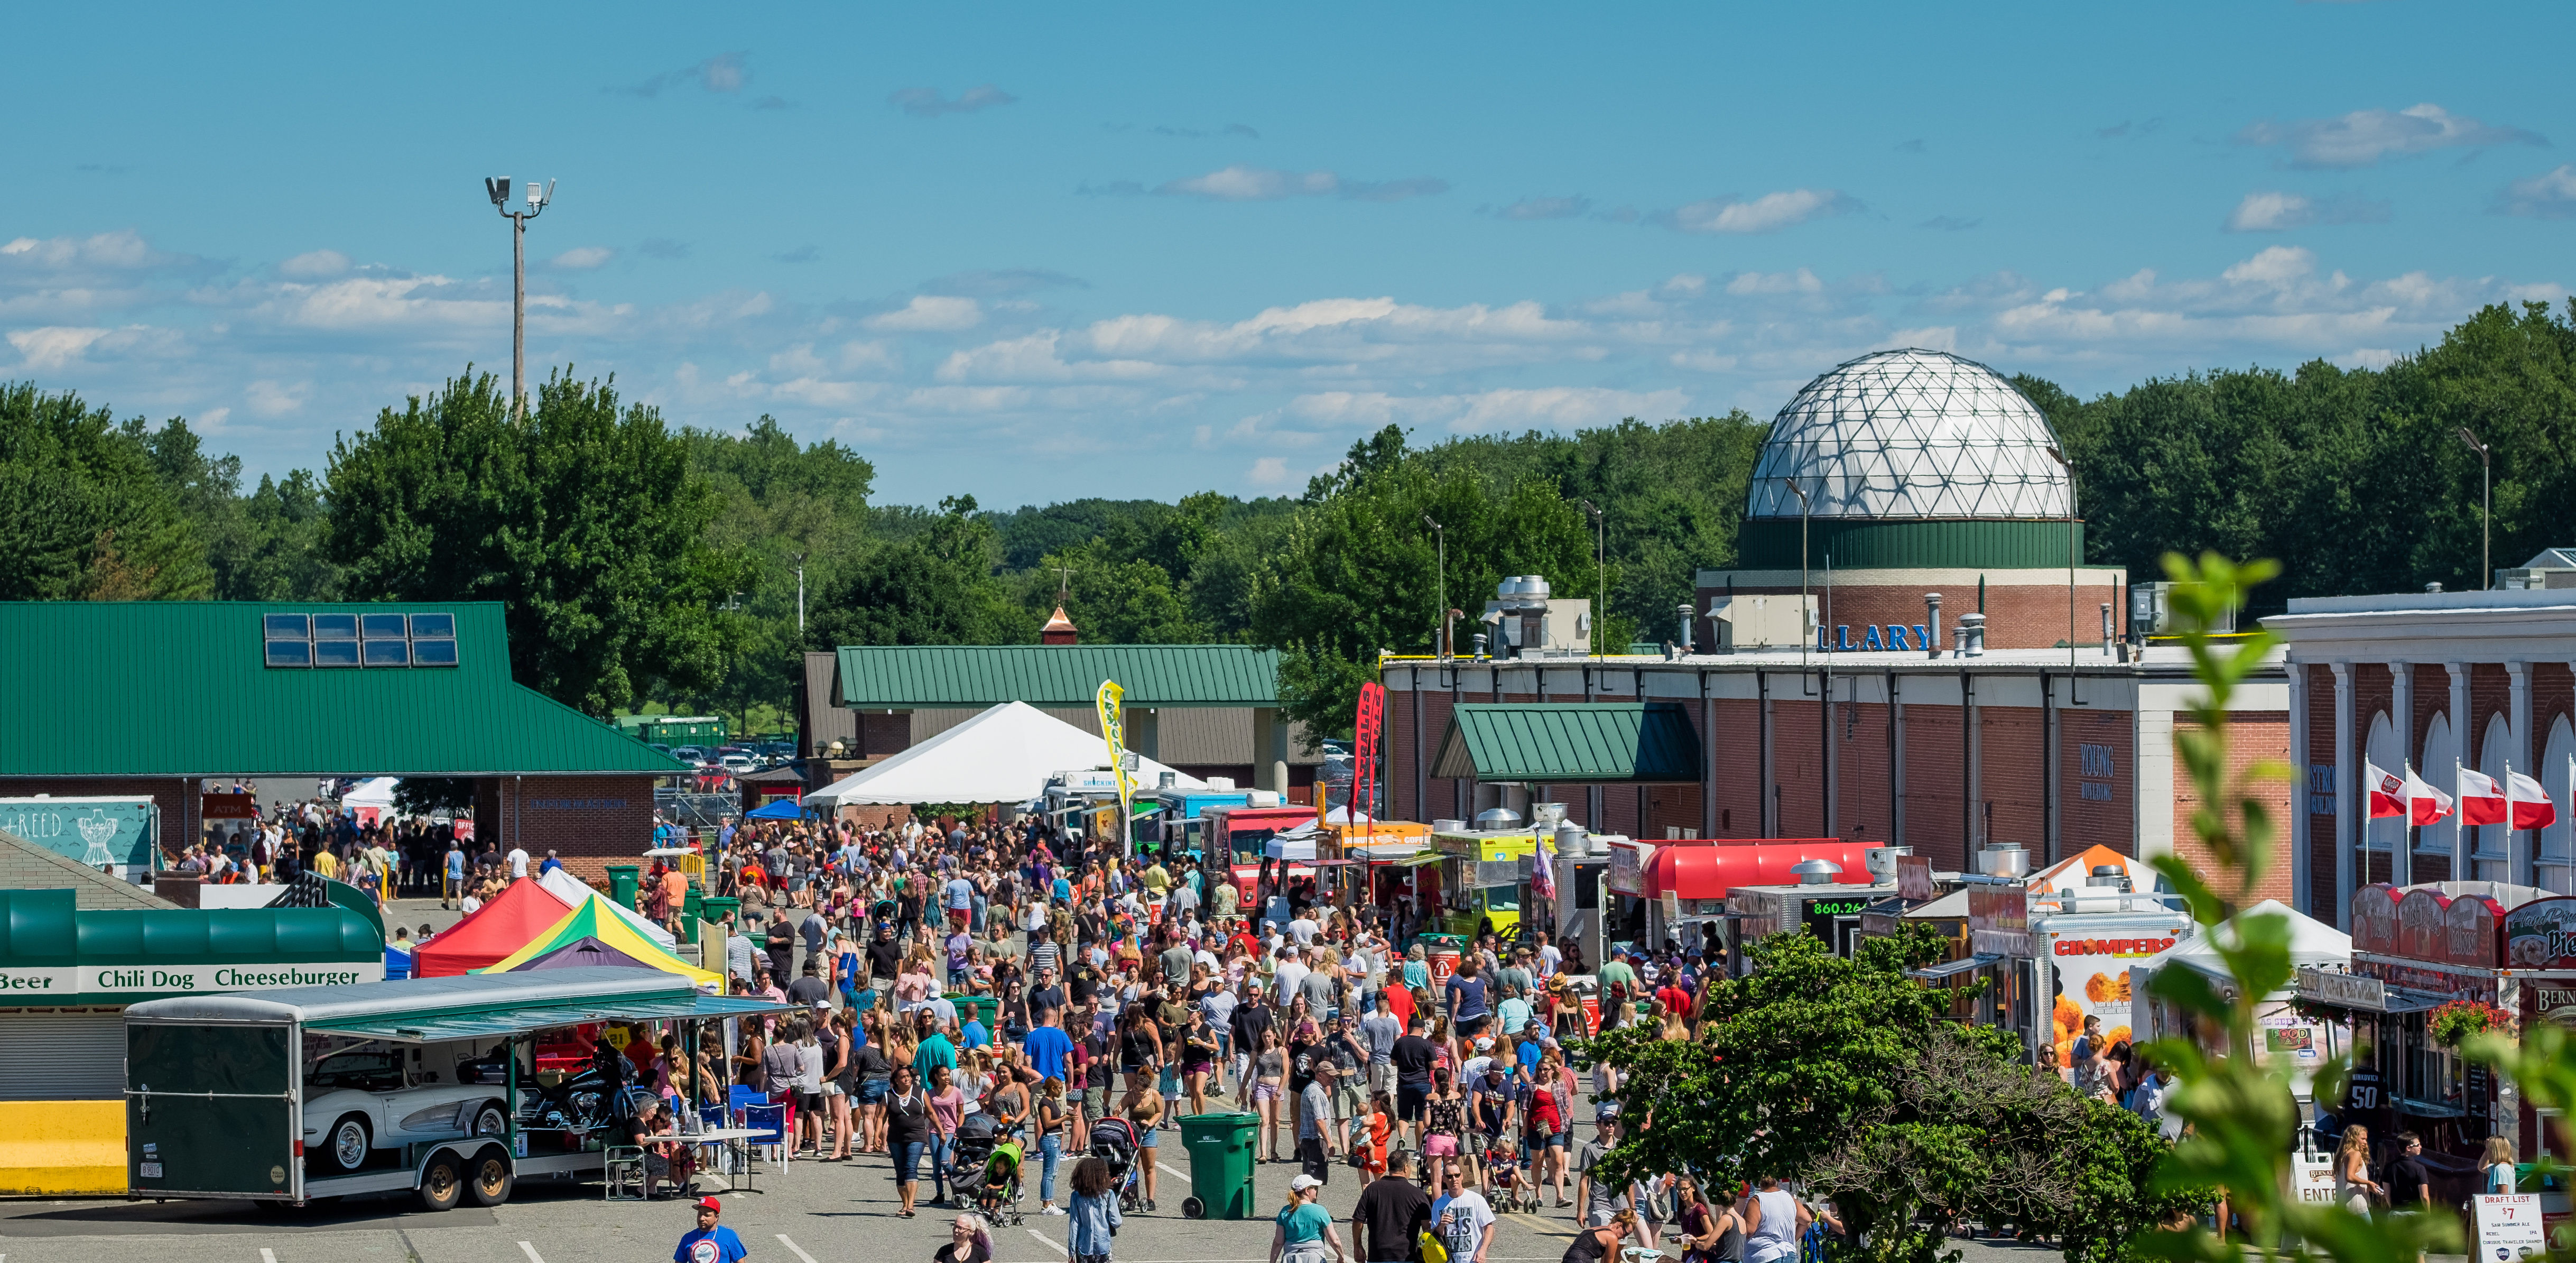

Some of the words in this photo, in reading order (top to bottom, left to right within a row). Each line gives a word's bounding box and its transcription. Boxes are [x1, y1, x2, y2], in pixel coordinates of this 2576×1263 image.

[2080, 743, 2114, 777] YOUNG
[2081, 782, 2112, 801] BUILDING
[531, 799, 627, 809] INFORMATION
[98, 970, 145, 988] Chili
[152, 971, 194, 989] Dog
[215, 968, 359, 987] Cheeseburger
[609, 1034, 624, 1045] 21
[2272, 1029, 2308, 1039] FOOD
[2352, 1086, 2377, 1109] 50
[2503, 1207, 2514, 1220] $7
